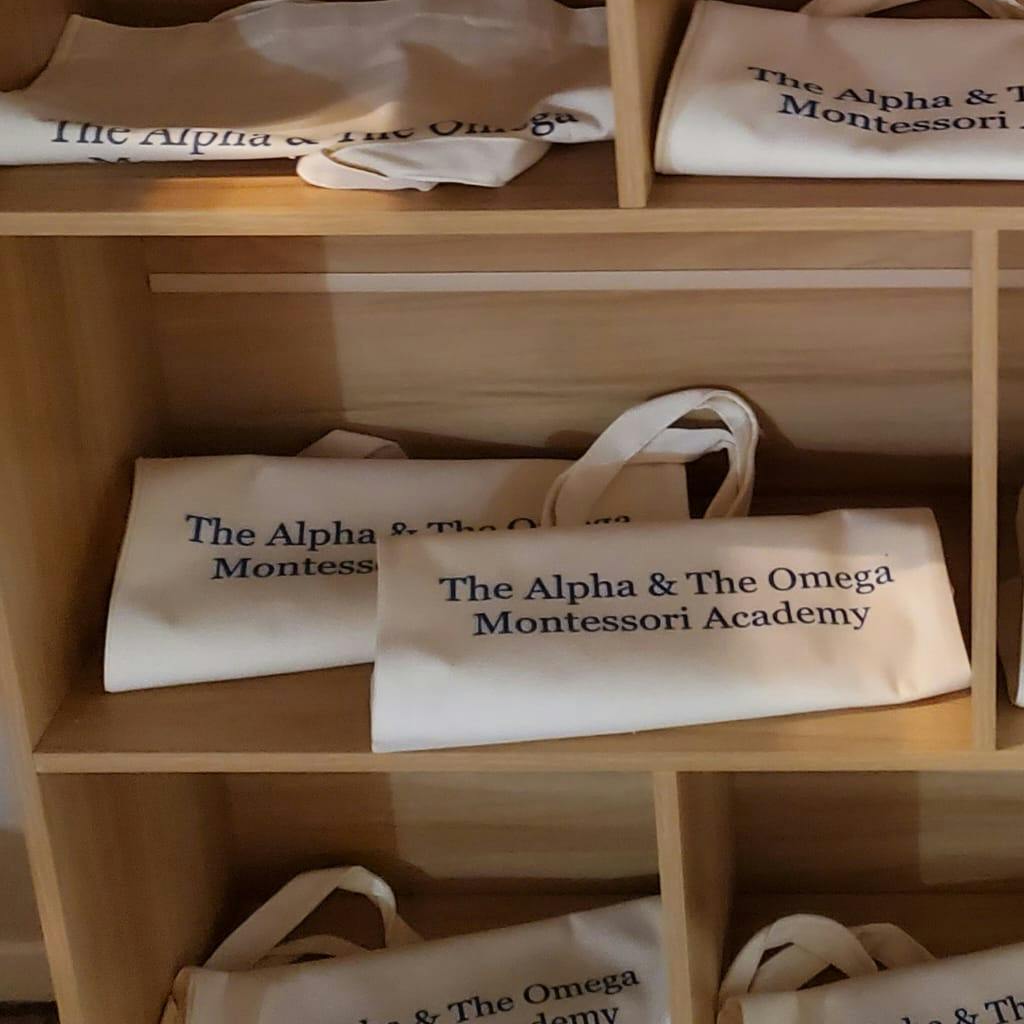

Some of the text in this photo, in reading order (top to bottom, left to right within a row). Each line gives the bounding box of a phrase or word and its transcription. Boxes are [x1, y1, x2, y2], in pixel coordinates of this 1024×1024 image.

[748, 66, 824, 95] The
[834, 88, 952, 112] Alpha
[964, 89, 998, 106] &
[777, 93, 1008, 135] Montessori
[185, 514, 256, 546] The
[264, 520, 376, 551] Alpha
[211, 557, 378, 580] Montess
[439, 561, 894, 607] The Alpha & The Omega
[472, 600, 873, 636] Montessori Academy
[447, 995, 514, 1024] The
[522, 969, 641, 1006] Omega
